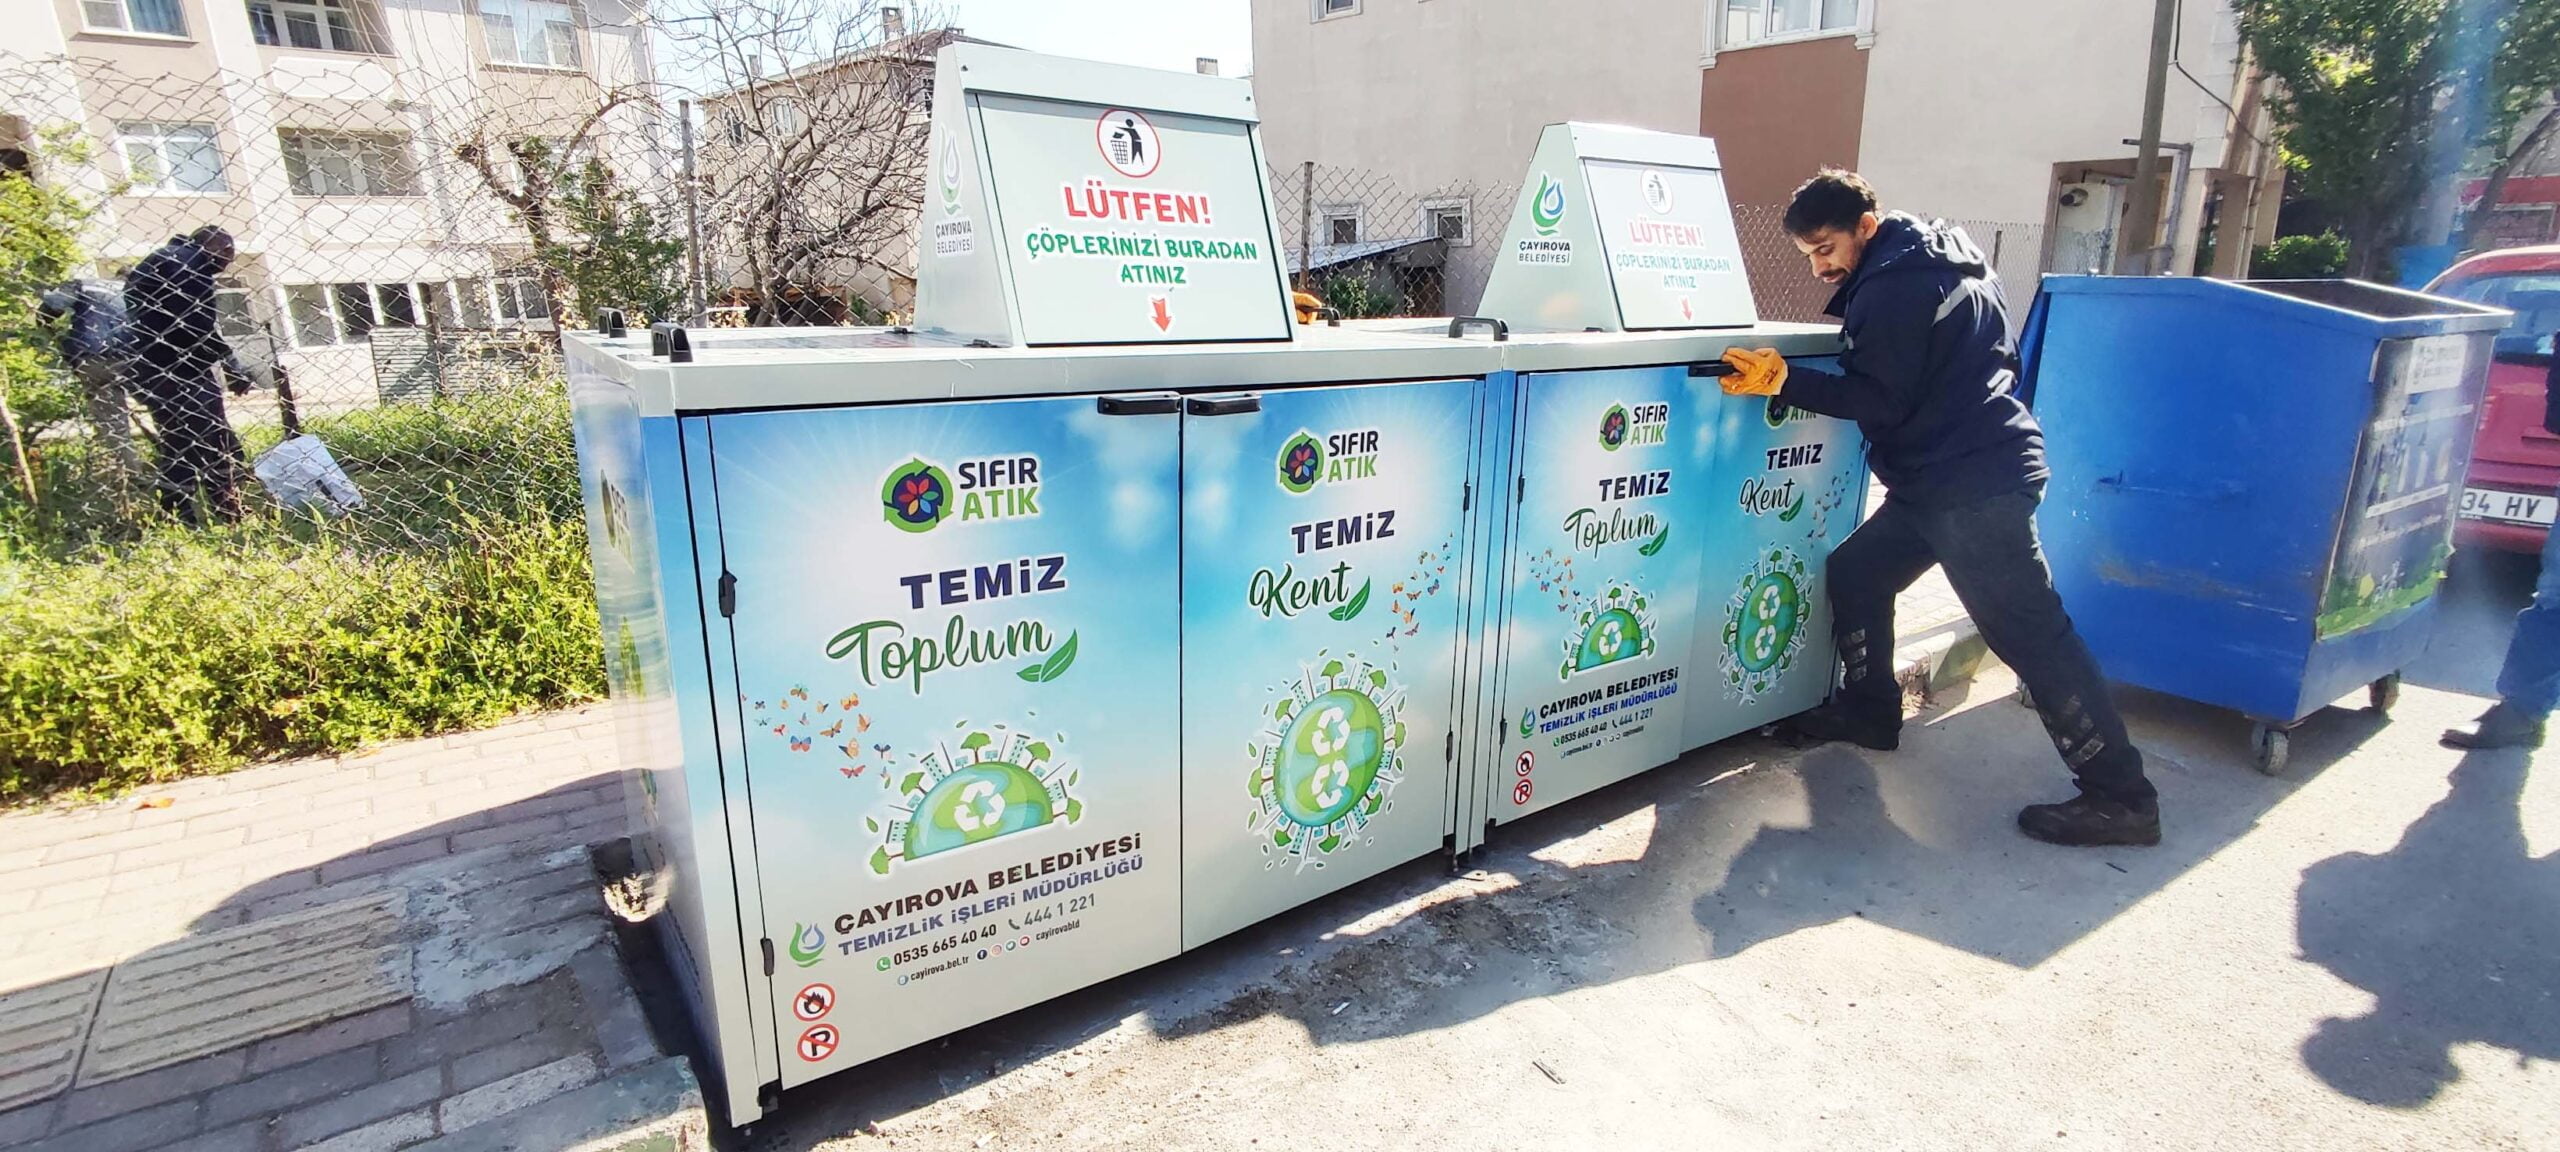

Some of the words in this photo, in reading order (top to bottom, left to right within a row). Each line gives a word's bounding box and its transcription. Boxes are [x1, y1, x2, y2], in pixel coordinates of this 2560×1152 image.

[1064, 181, 1211, 224] LÜTFEN!
[1027, 227, 1161, 260] ÇÖPLERİNİZİ
[1165, 240, 1257, 260] BURADAN
[1629, 217, 1704, 246] LÜTFEN!
[1121, 266, 1187, 284] ATINIZ
[1616, 250, 1682, 271] ÇÖPLERİNİZİ
[1683, 257, 1731, 271] BURADAN
[1664, 275, 1696, 288] ATINIZ
[1633, 404, 1668, 424] SIFIR
[1329, 430, 1379, 457] SIFIR
[1630, 424, 1666, 445] ATIK
[958, 457, 1038, 490] SIFIR
[1327, 454, 1377, 483] ATIK
[962, 486, 1039, 521] ATIK
[1740, 477, 1795, 515] Kent
[2461, 492, 2490, 513] 34
[1563, 507, 1657, 559] Toplum
[1249, 561, 1352, 617] Kent
[826, 614, 1052, 694] Toplum
[1539, 689, 1603, 719] ÇAYIROVA
[1022, 856, 1144, 901] MÜDÜRLÜĞÜ
[834, 879, 979, 936] ÇAYIROVA
[893, 944, 929, 966] 0535
[932, 936, 957, 957] 665
[961, 929, 978, 945] 40
[980, 923, 997, 939] 40
[1024, 907, 1052, 926] 444
[1057, 903, 1065, 916] 1
[1070, 893, 1095, 913] 221
[910, 955, 969, 982] cayirova.bel.tr
[1035, 919, 1080, 941] cayirovabld
